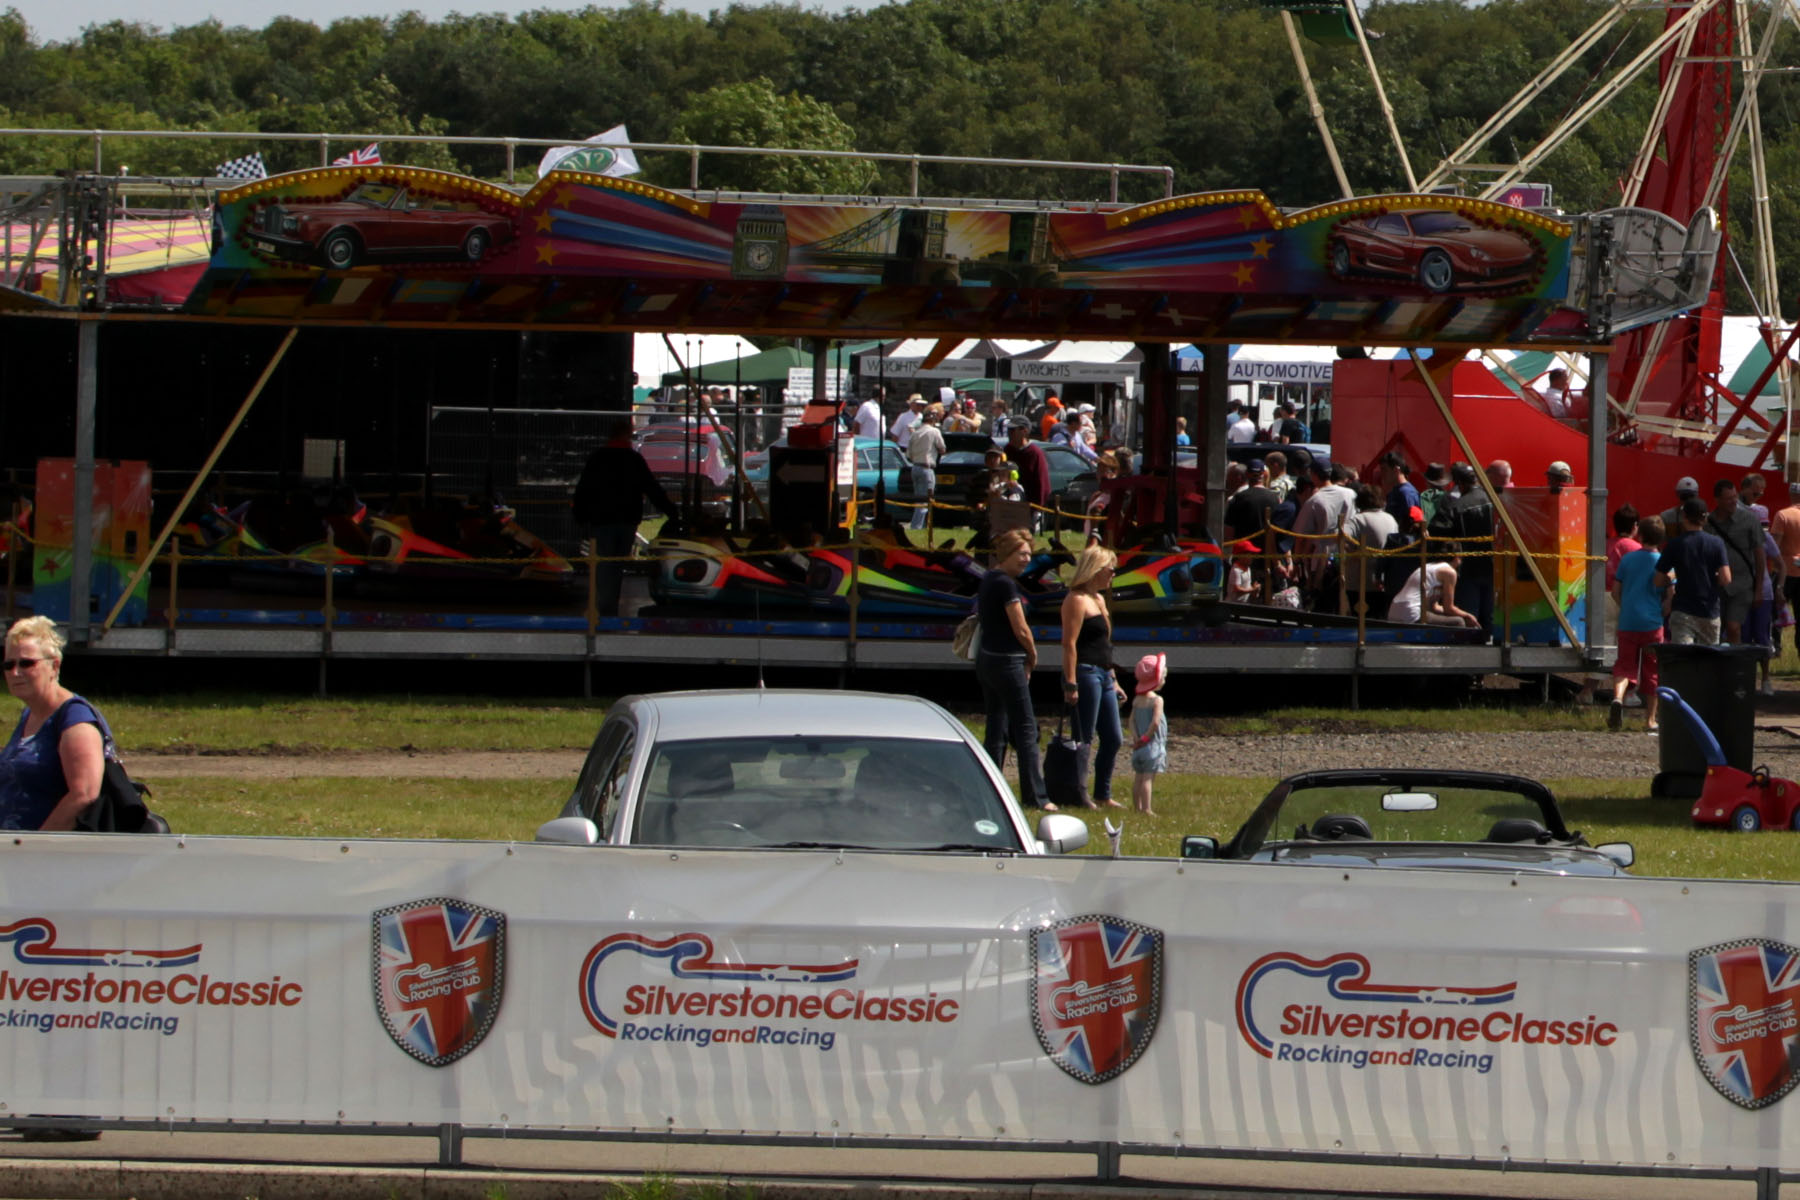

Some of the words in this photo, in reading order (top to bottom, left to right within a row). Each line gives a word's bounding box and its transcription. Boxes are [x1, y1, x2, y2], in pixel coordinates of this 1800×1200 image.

[1017, 363, 1071, 377] WRIGHTS
[1233, 363, 1332, 380] AUTOMOTIVE
[0, 970, 303, 1006] lverstoneClassic
[411, 983, 451, 1002] Racing
[453, 975, 481, 990] Club
[623, 984, 960, 1023] SilverstoneClassic
[1066, 1001, 1108, 1020] Racing
[1109, 992, 1138, 1008] Club
[621, 1022, 836, 1051] RockingandRacing
[1280, 1004, 1618, 1046] SilverstoneClassic
[1726, 1025, 1768, 1044] Racing
[1769, 1016, 1797, 1032] Club
[1277, 1042, 1494, 1074] RockingandRacing
